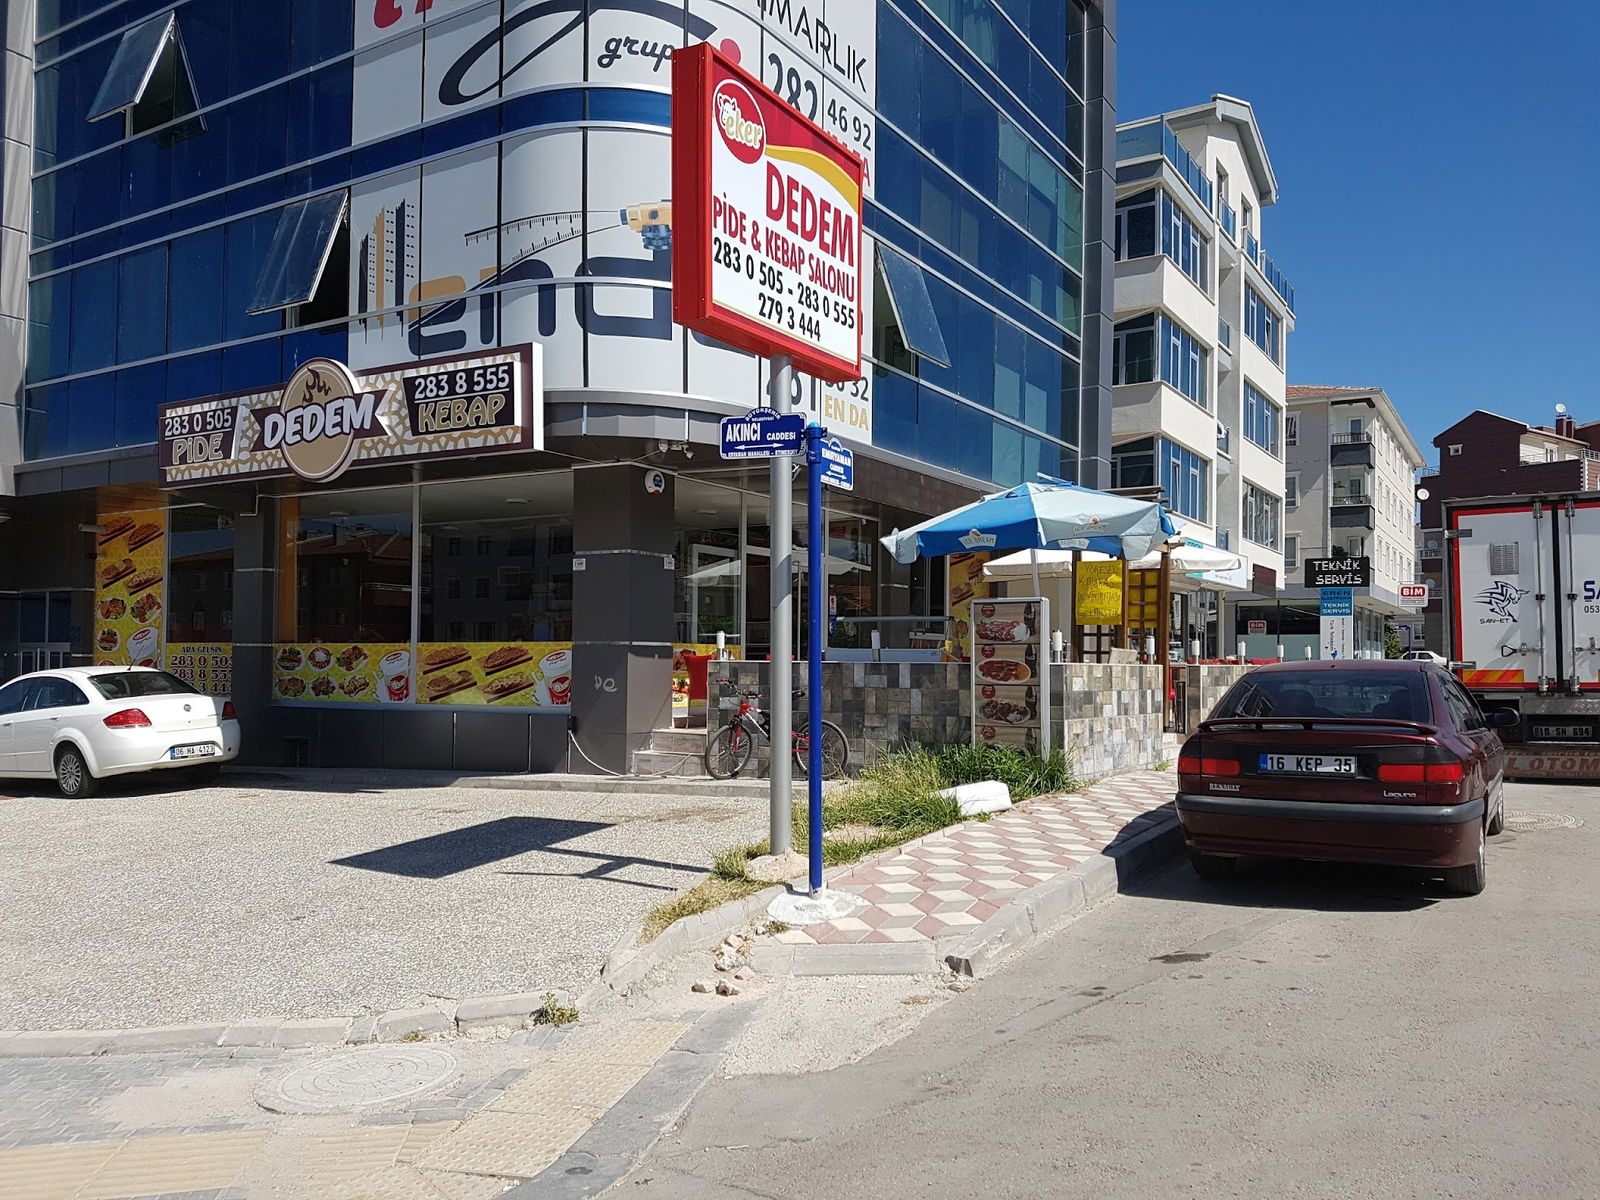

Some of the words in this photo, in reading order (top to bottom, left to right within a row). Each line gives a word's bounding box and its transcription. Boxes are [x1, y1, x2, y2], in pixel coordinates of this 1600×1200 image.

[757, 0, 867, 93] MARLIK
[827, 98, 848, 132] 46
[853, 115, 872, 151] 92
[766, 160, 854, 267] DEDEM
[713, 192, 747, 245] PİDE
[751, 220, 762, 253] &
[765, 227, 805, 275] KEBAP
[808, 253, 855, 302] SALONU
[713, 237, 741, 273] 283
[746, 255, 755, 280] 0
[759, 261, 783, 295] 505
[797, 282, 820, 313] 283
[823, 296, 830, 318] 0
[833, 301, 855, 330] 555
[758, 292, 783, 324] 279
[787, 306, 795, 330] 3
[799, 313, 821, 342] 444
[414, 375, 449, 400] 283
[455, 371, 467, 394] 8
[473, 365, 510, 392] 555
[164, 413, 190, 437] 283
[193, 411, 202, 433] 0
[206, 408, 232, 431] 505
[263, 393, 375, 449] DEDEM
[418, 393, 506, 433] KEBAP
[172, 432, 223, 465] PİDE
[726, 422, 761, 442] AKINCI
[1313, 558, 1360, 571] TEKNİK
[1315, 572, 1362, 585] SERVİS
[171, 655, 194, 667] 283
[198, 655, 207, 667] 0
[198, 668, 207, 679] 8
[1268, 756, 1285, 770] 16
[1296, 757, 1322, 771] KEP
[1334, 758, 1352, 772] 35
[1209, 783, 1240, 791] RENAULT
[1383, 790, 1417, 799] Laguna
